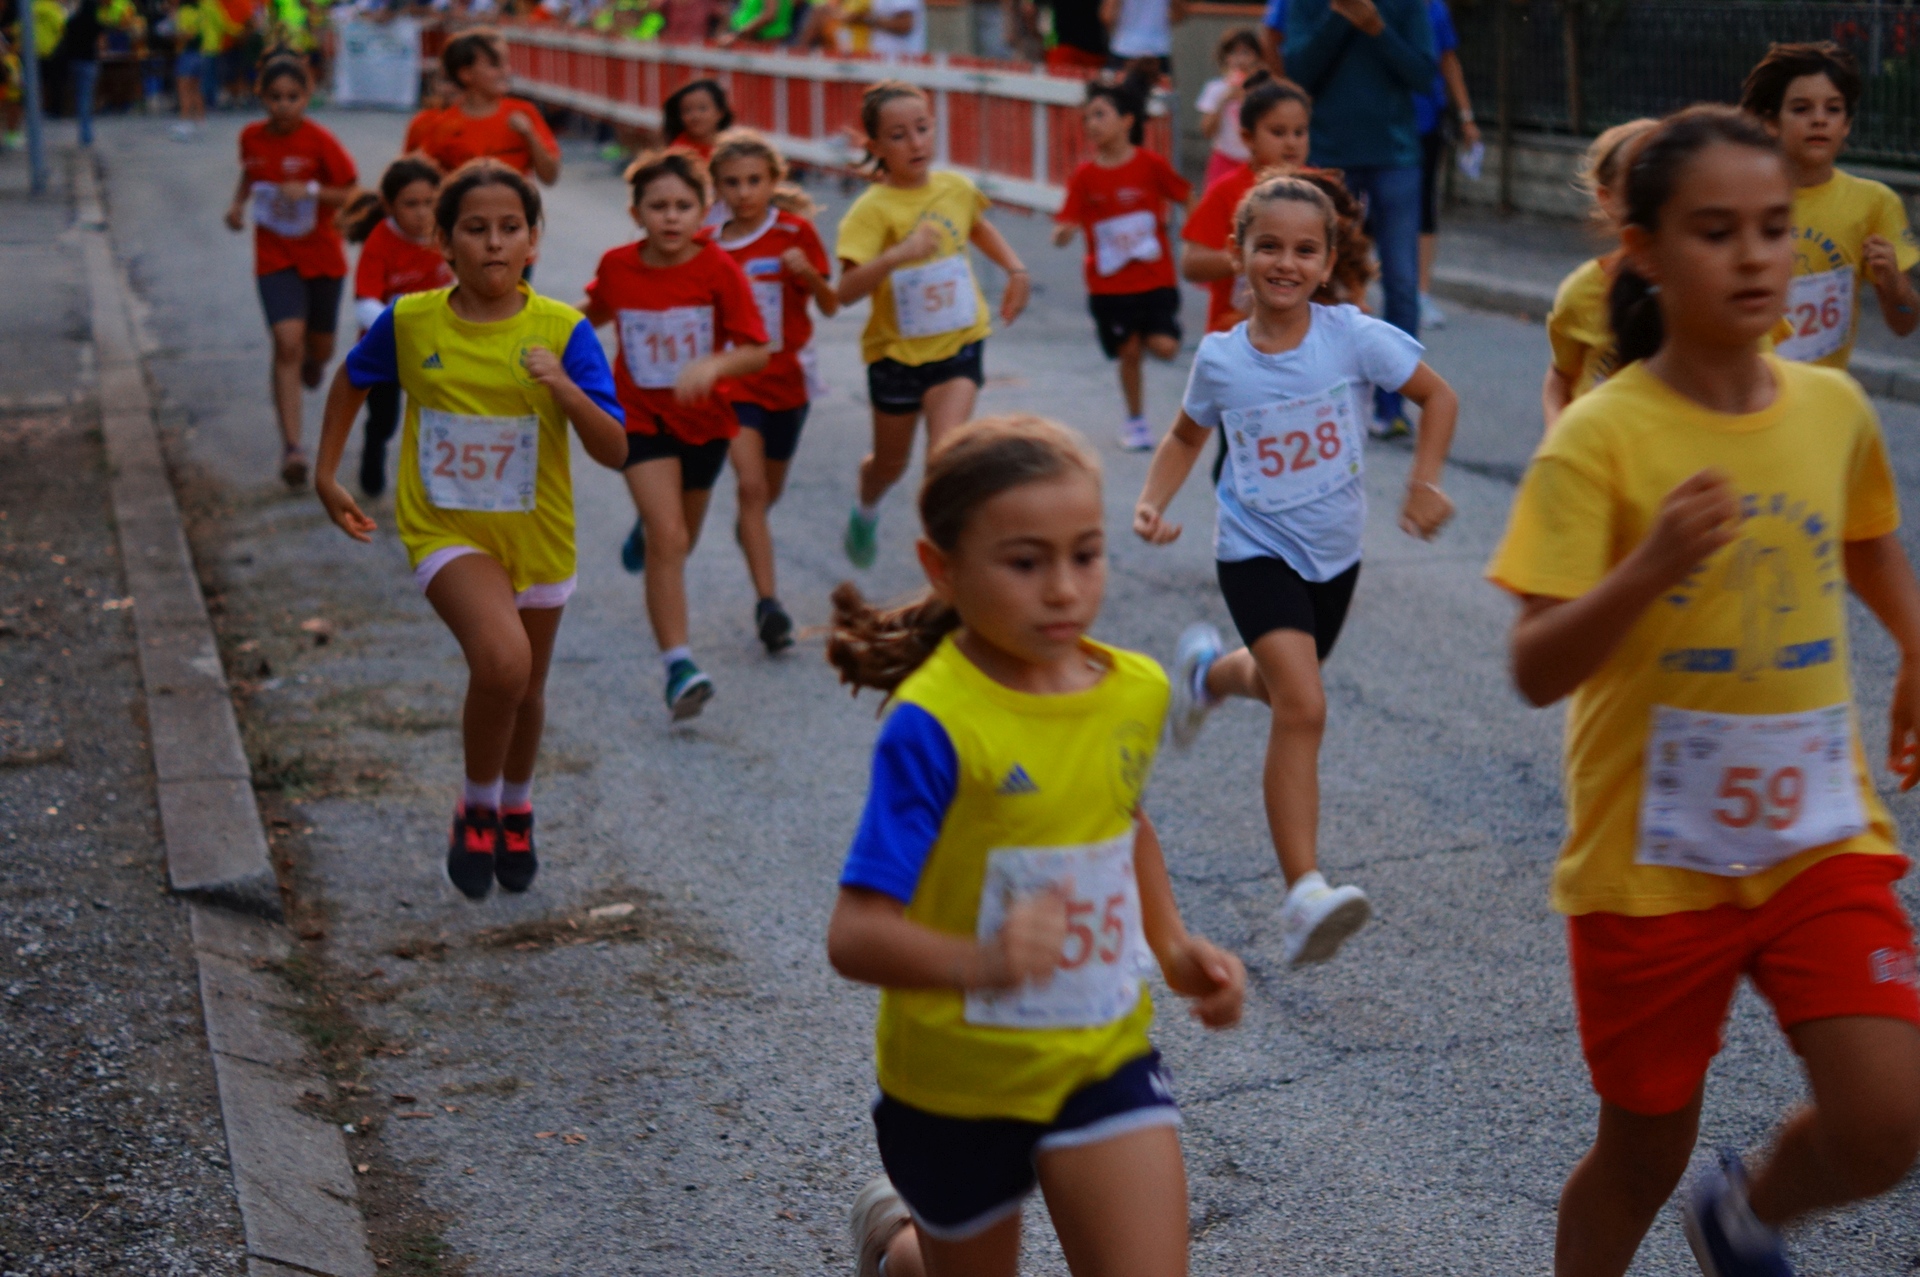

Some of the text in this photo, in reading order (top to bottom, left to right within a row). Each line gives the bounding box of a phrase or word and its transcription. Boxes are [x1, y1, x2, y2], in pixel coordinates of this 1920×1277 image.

[1783, 296, 1841, 337] 26
[645, 333, 697, 364] 111
[433, 440, 516, 481] 257
[1256, 421, 1342, 478] 528
[1711, 766, 1806, 831] 59
